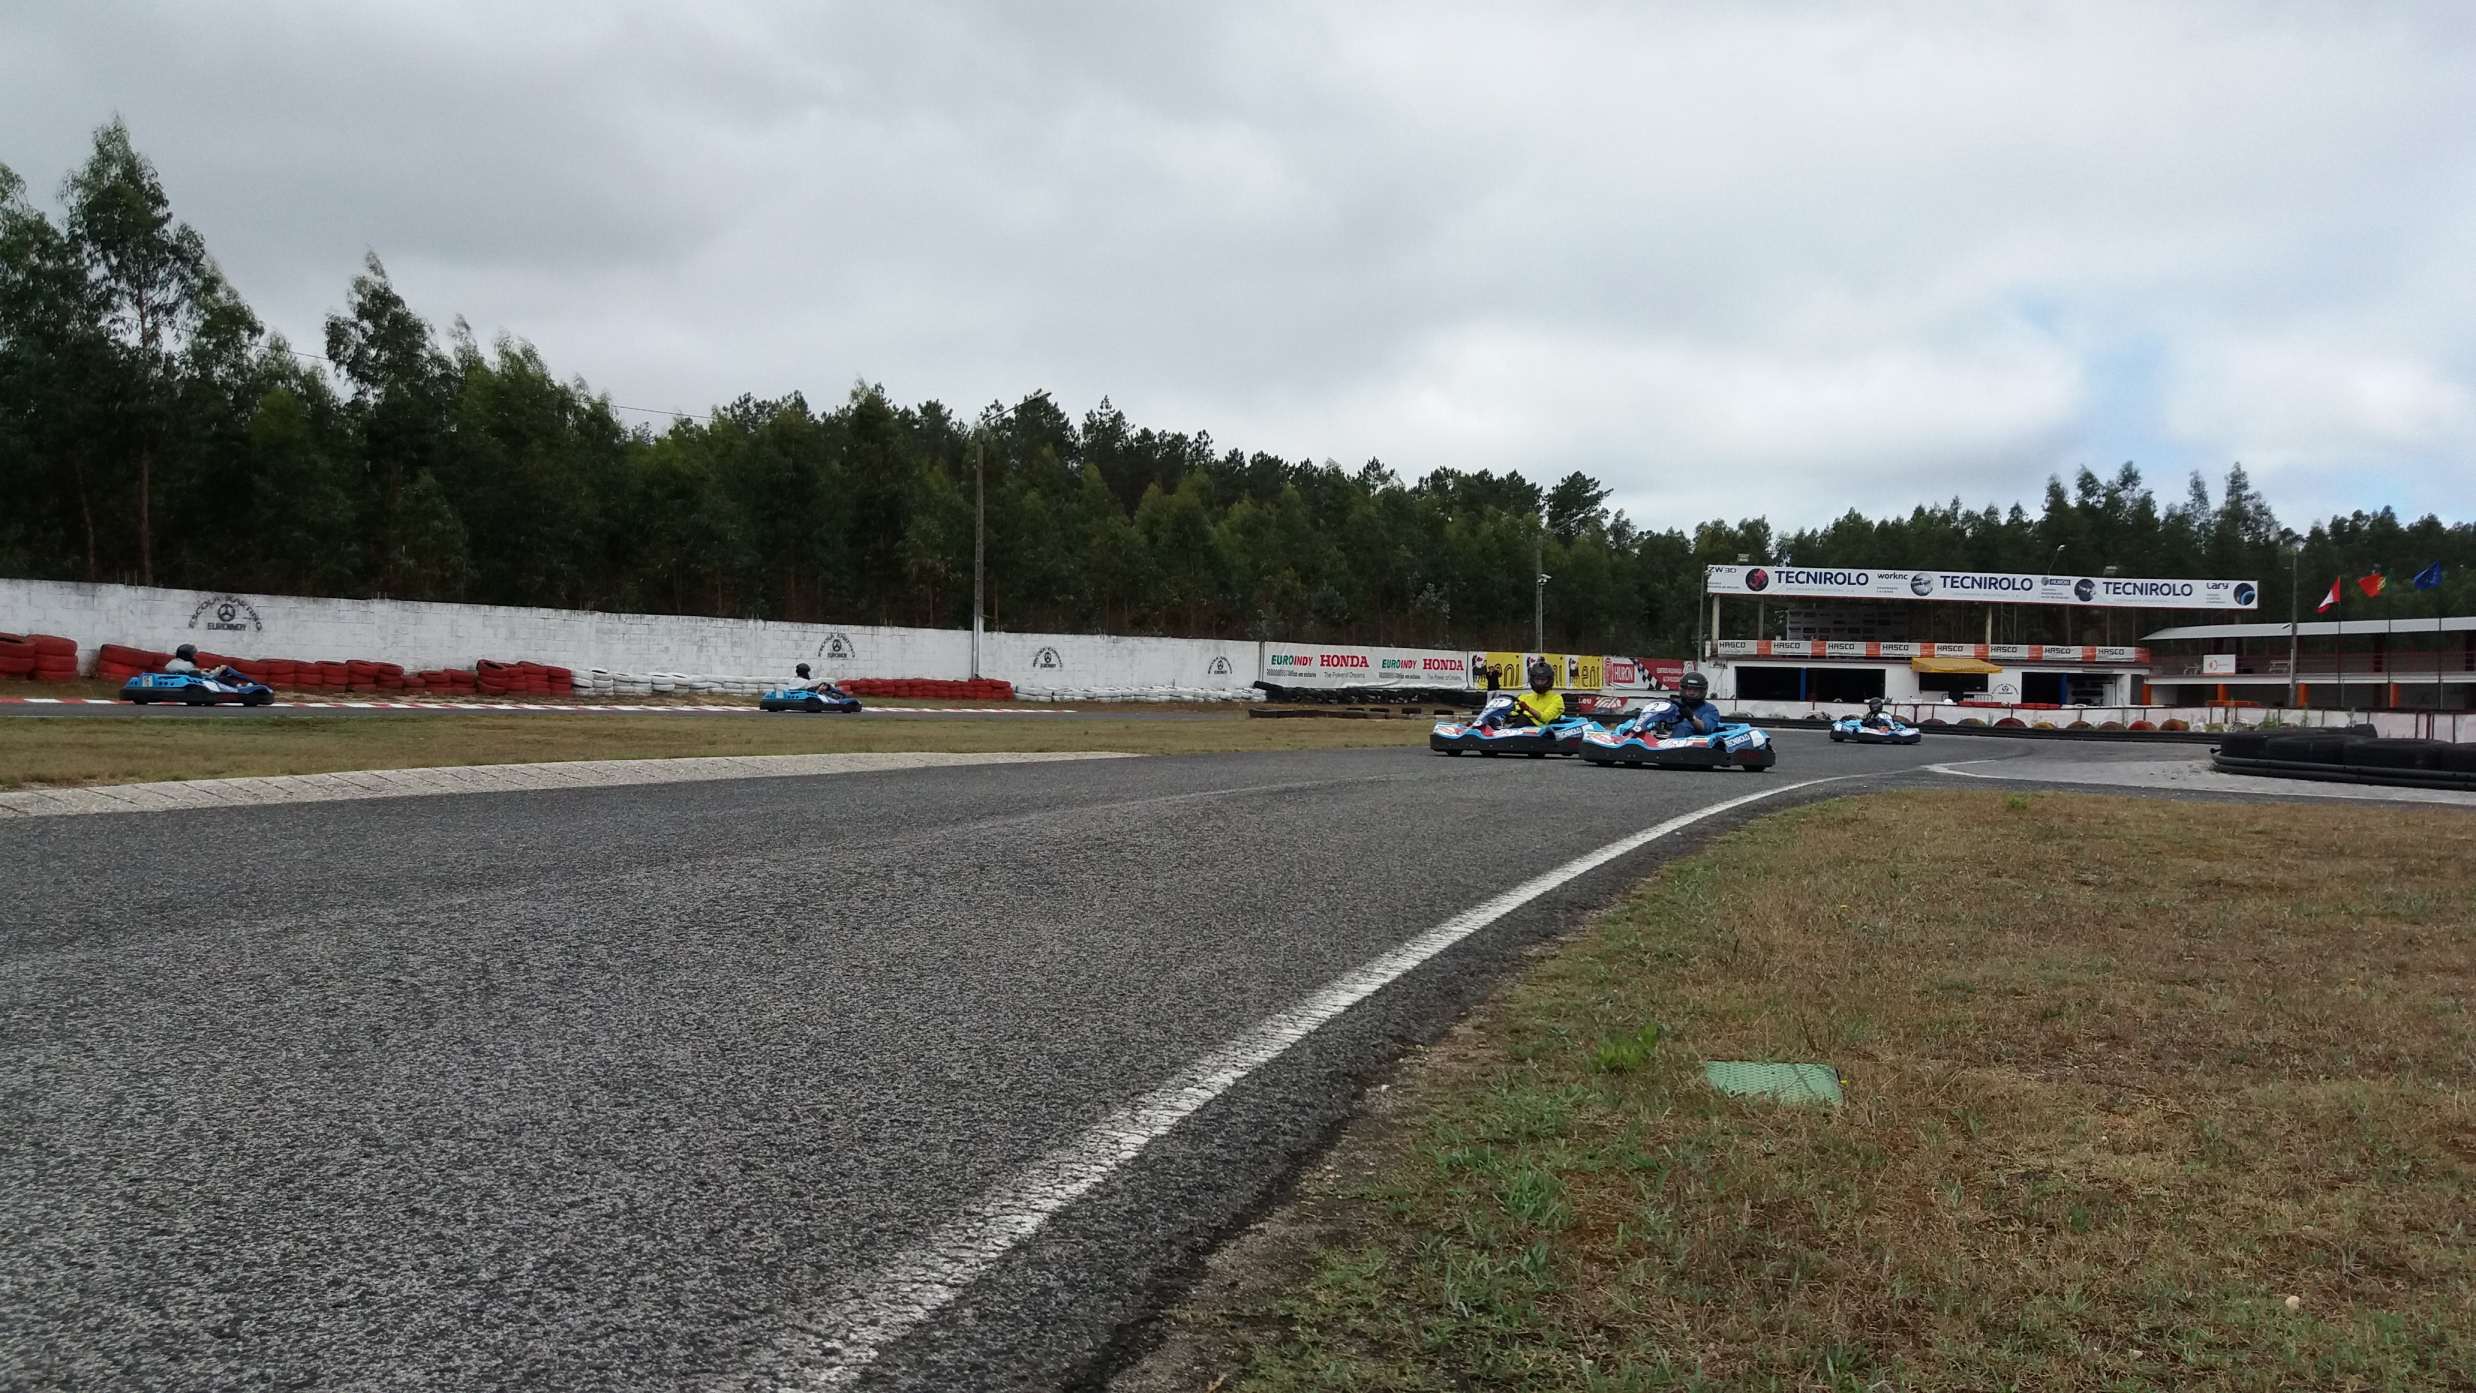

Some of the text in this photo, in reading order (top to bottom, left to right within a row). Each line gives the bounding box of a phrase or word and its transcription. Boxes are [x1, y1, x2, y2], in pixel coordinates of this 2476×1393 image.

[1775, 570, 1869, 586] TECNIROLO
[1877, 572, 1908, 580] worknc
[1940, 575, 2033, 591] TECNIROLO
[2102, 582, 2193, 597] TECNIROLO
[1936, 644, 1964, 652] HASCO
[2044, 647, 2071, 655] HASCO
[2097, 648, 2125, 656] HASCO
[1271, 654, 1370, 668] EUROINDY HONDA
[1381, 658, 1465, 671] EUROINDY HONDA
[1614, 666, 1633, 681] HURON
